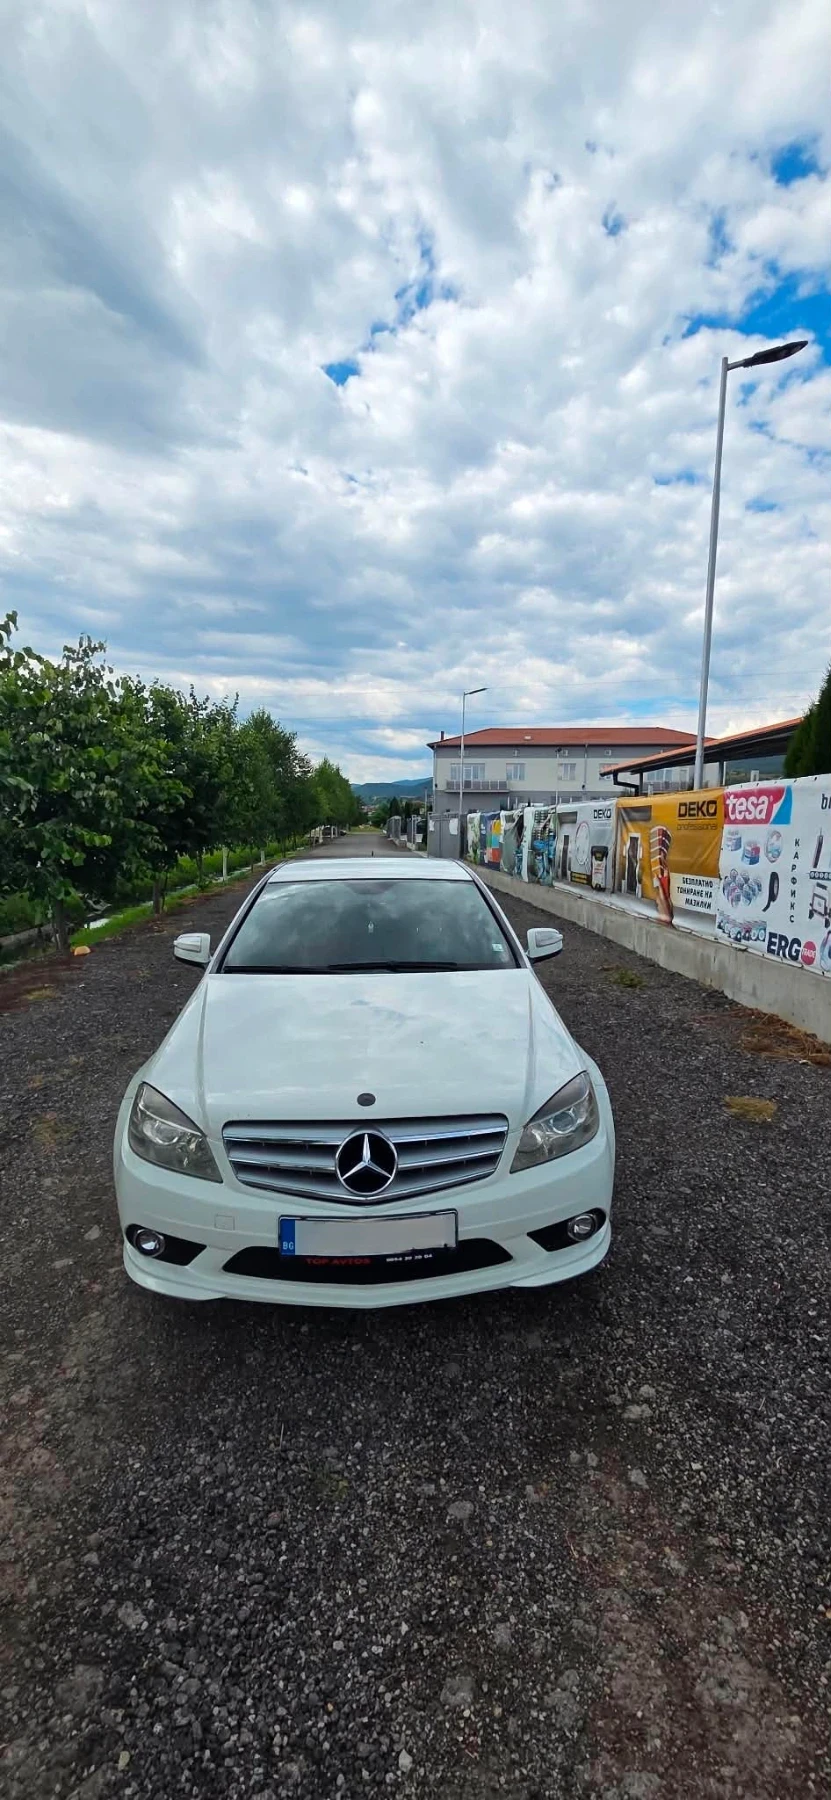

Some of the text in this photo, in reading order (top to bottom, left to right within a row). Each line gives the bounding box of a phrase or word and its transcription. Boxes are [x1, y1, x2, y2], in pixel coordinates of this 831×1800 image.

[726, 794, 769, 820] tesa
[821, 793, 831, 810] b
[593, 808, 611, 819] DEKO
[678, 800, 717, 818] DEKO
[682, 877, 713, 888] БЕЗПЛАТНО
[677, 886, 713, 898] ТОНИРАНЕ НА
[685, 898, 711, 909] МАЗИЛКИ
[801, 947, 816, 958] TRADE
[282, 1241, 294, 1250] BG
